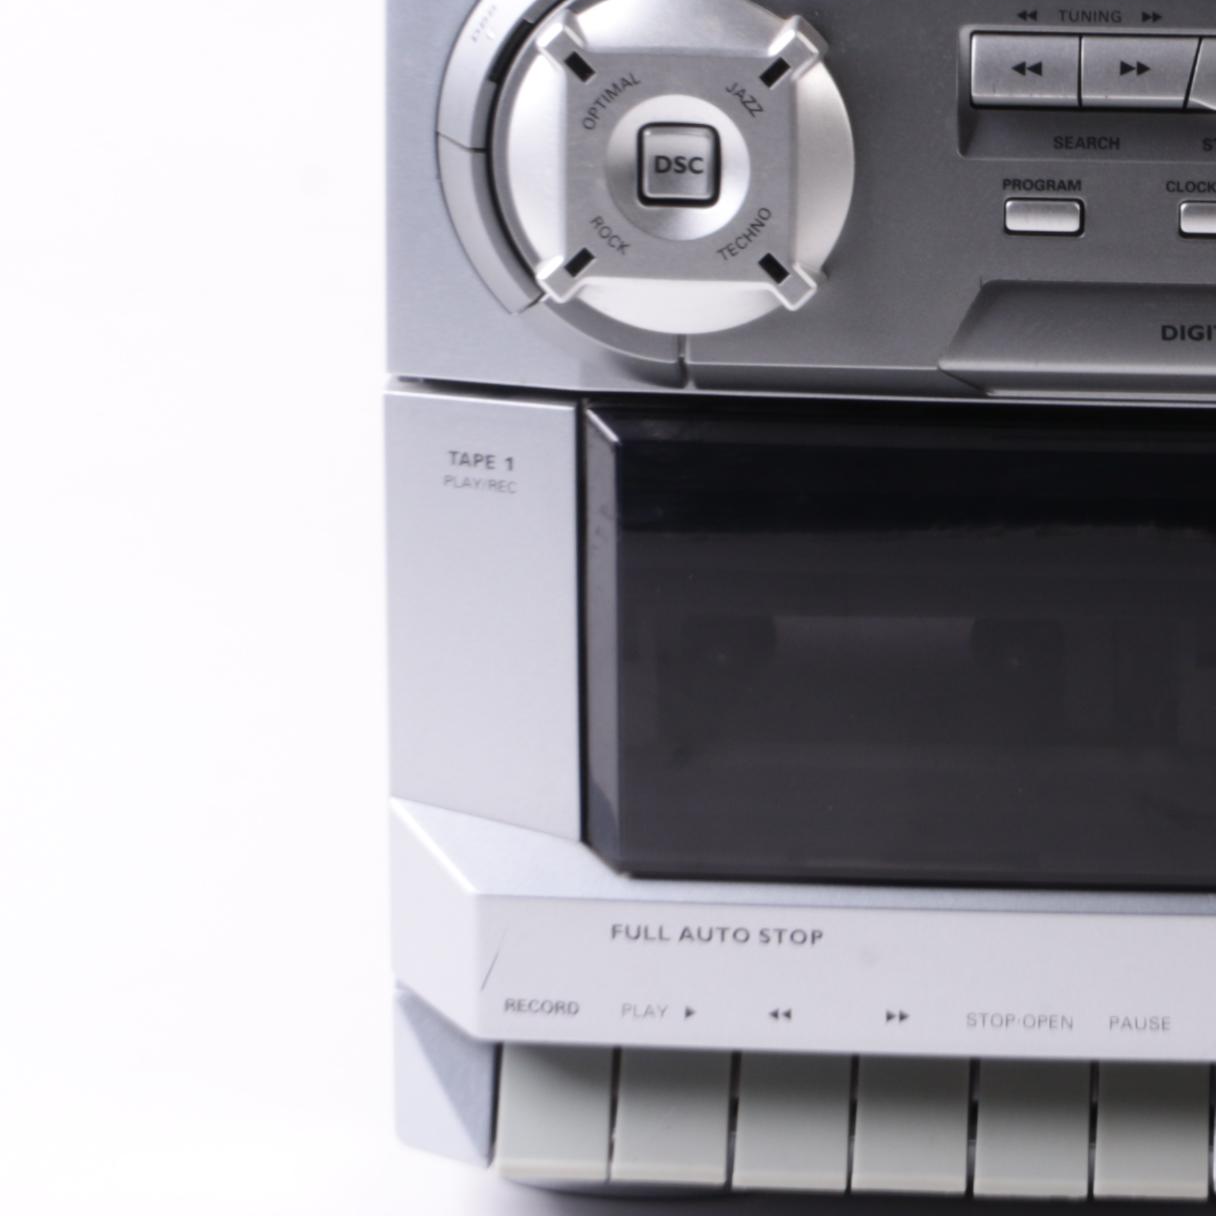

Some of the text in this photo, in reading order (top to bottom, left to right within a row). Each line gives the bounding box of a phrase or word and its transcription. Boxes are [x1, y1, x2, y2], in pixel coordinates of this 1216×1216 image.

[1059, 9, 1122, 24] TUNING
[582, 72, 641, 130] OPTIMAL
[725, 82, 765, 118] JAZZ
[1053, 136, 1120, 151] SEARCH
[654, 155, 705, 174] DSC
[1002, 178, 1082, 192] PROGRAM
[589, 215, 631, 256] ROCK
[716, 207, 772, 261] TECHNO
[448, 449, 515, 472] TAPE 1
[611, 923, 824, 946] FULL AUTO STOP
[504, 998, 580, 1016] RECORD
[621, 1002, 669, 1020] PLAY
[1109, 1015, 1171, 1032] PAUSE
